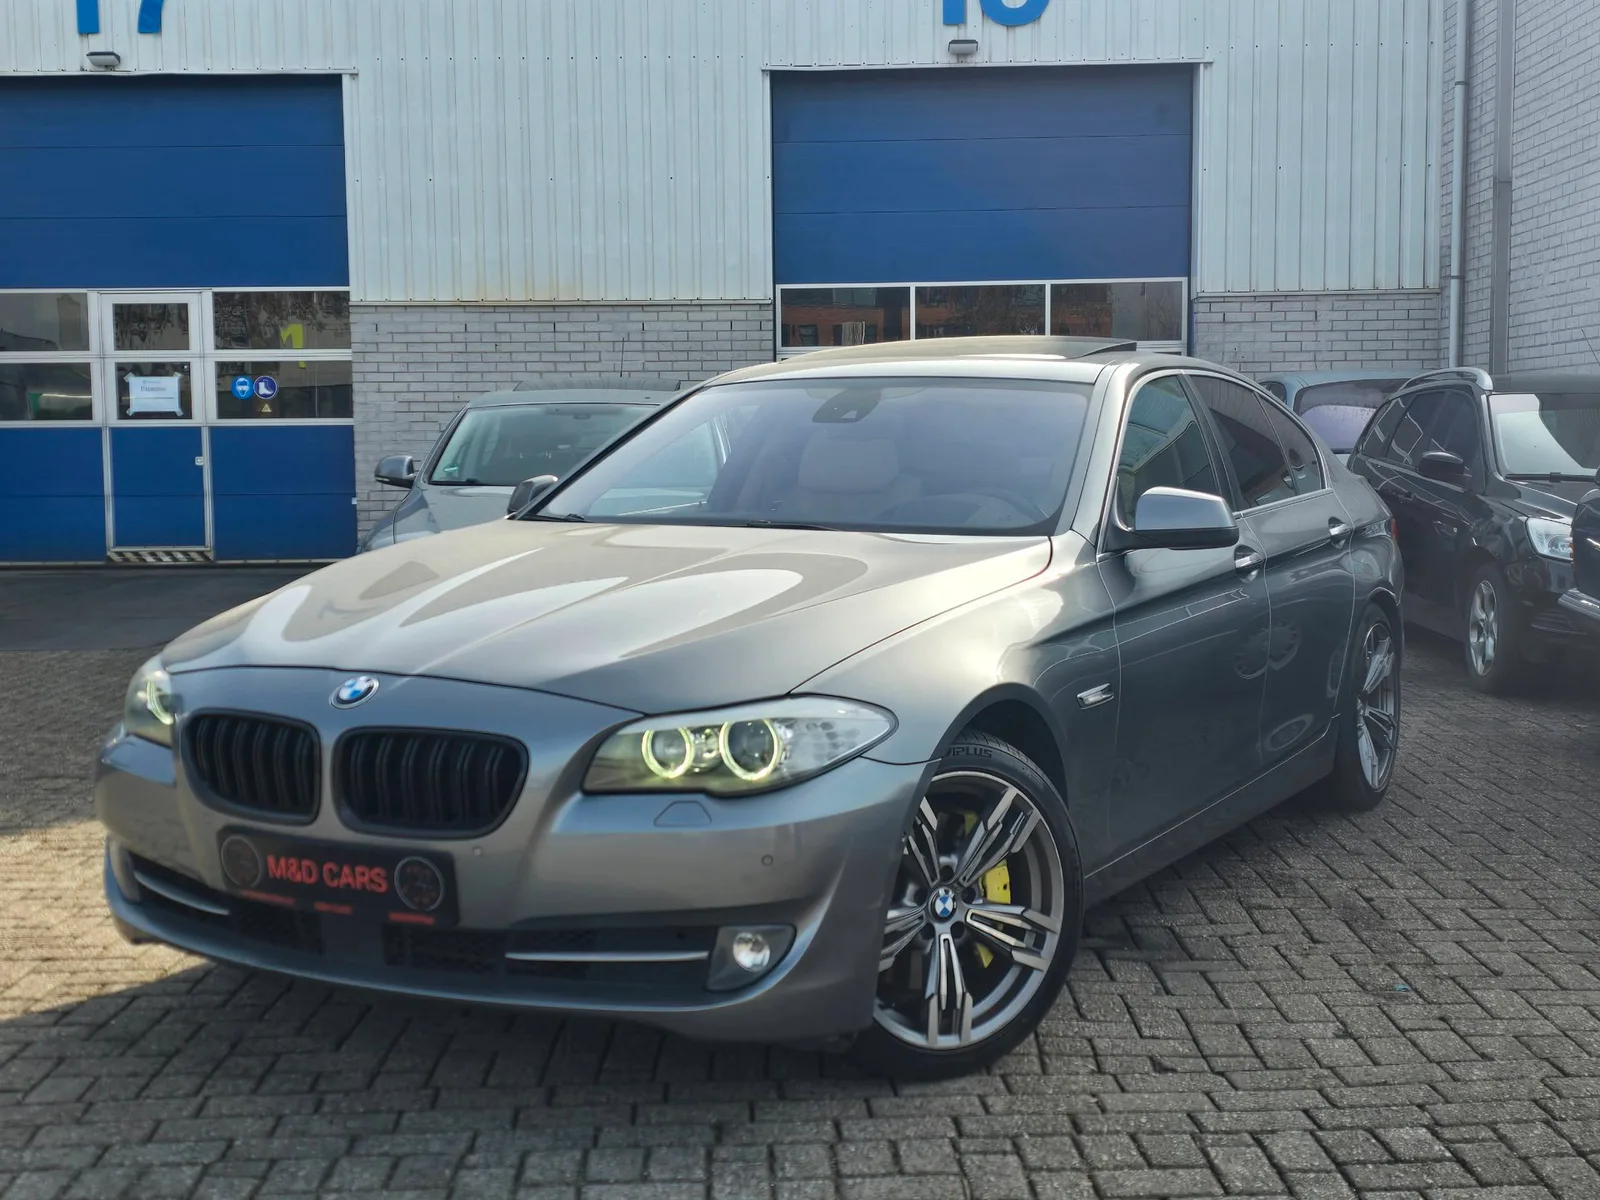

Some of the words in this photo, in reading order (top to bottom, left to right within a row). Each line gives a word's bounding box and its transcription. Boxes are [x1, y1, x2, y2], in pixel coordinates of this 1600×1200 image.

[950, 746, 993, 759] PLUS
[266, 854, 318, 885] M&D
[322, 861, 389, 893] CARS
